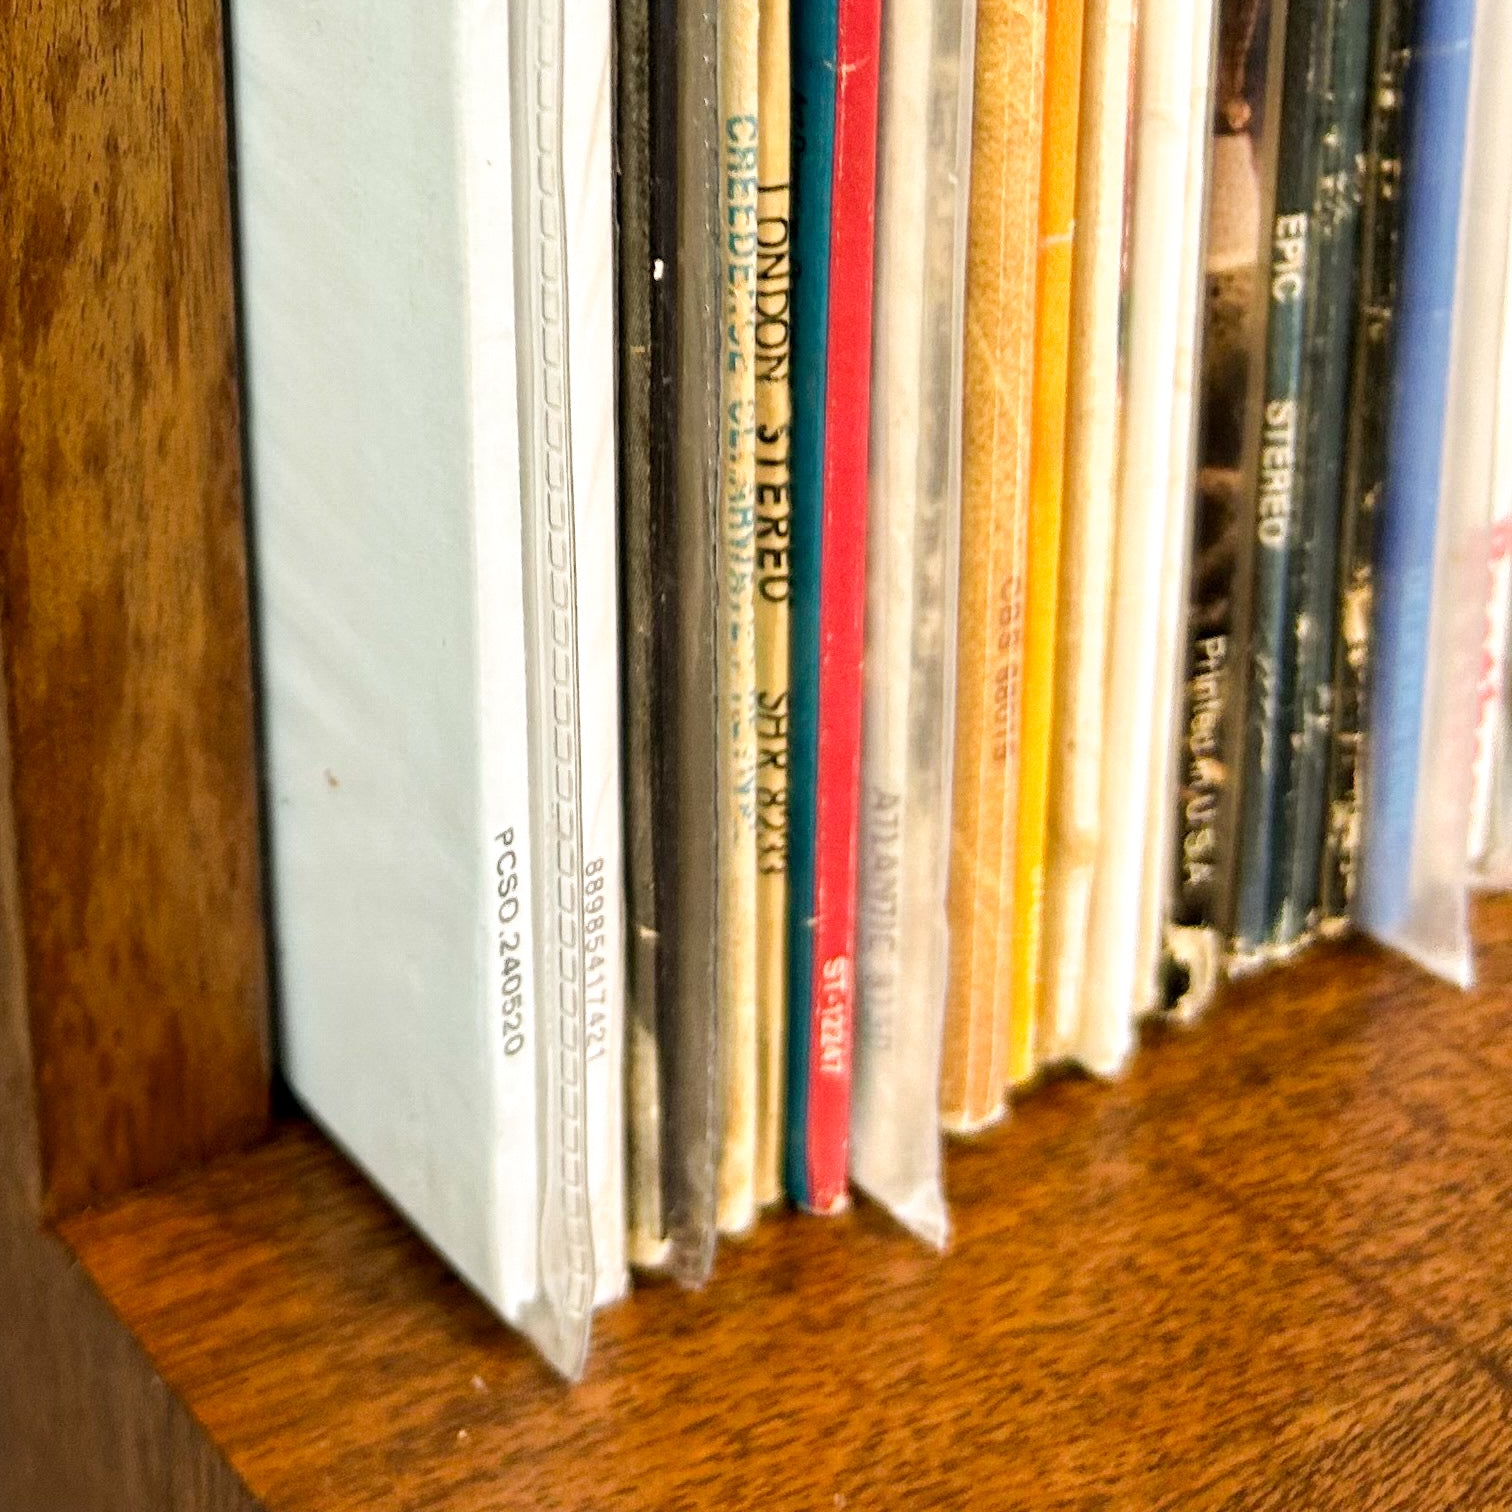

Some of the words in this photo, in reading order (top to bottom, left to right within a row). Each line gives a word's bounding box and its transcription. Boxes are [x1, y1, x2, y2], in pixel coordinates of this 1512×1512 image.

[1270, 210, 1309, 306] EPIC
[1255, 399, 1300, 551] STEREO
[864, 790, 901, 953] ATLANTIC
